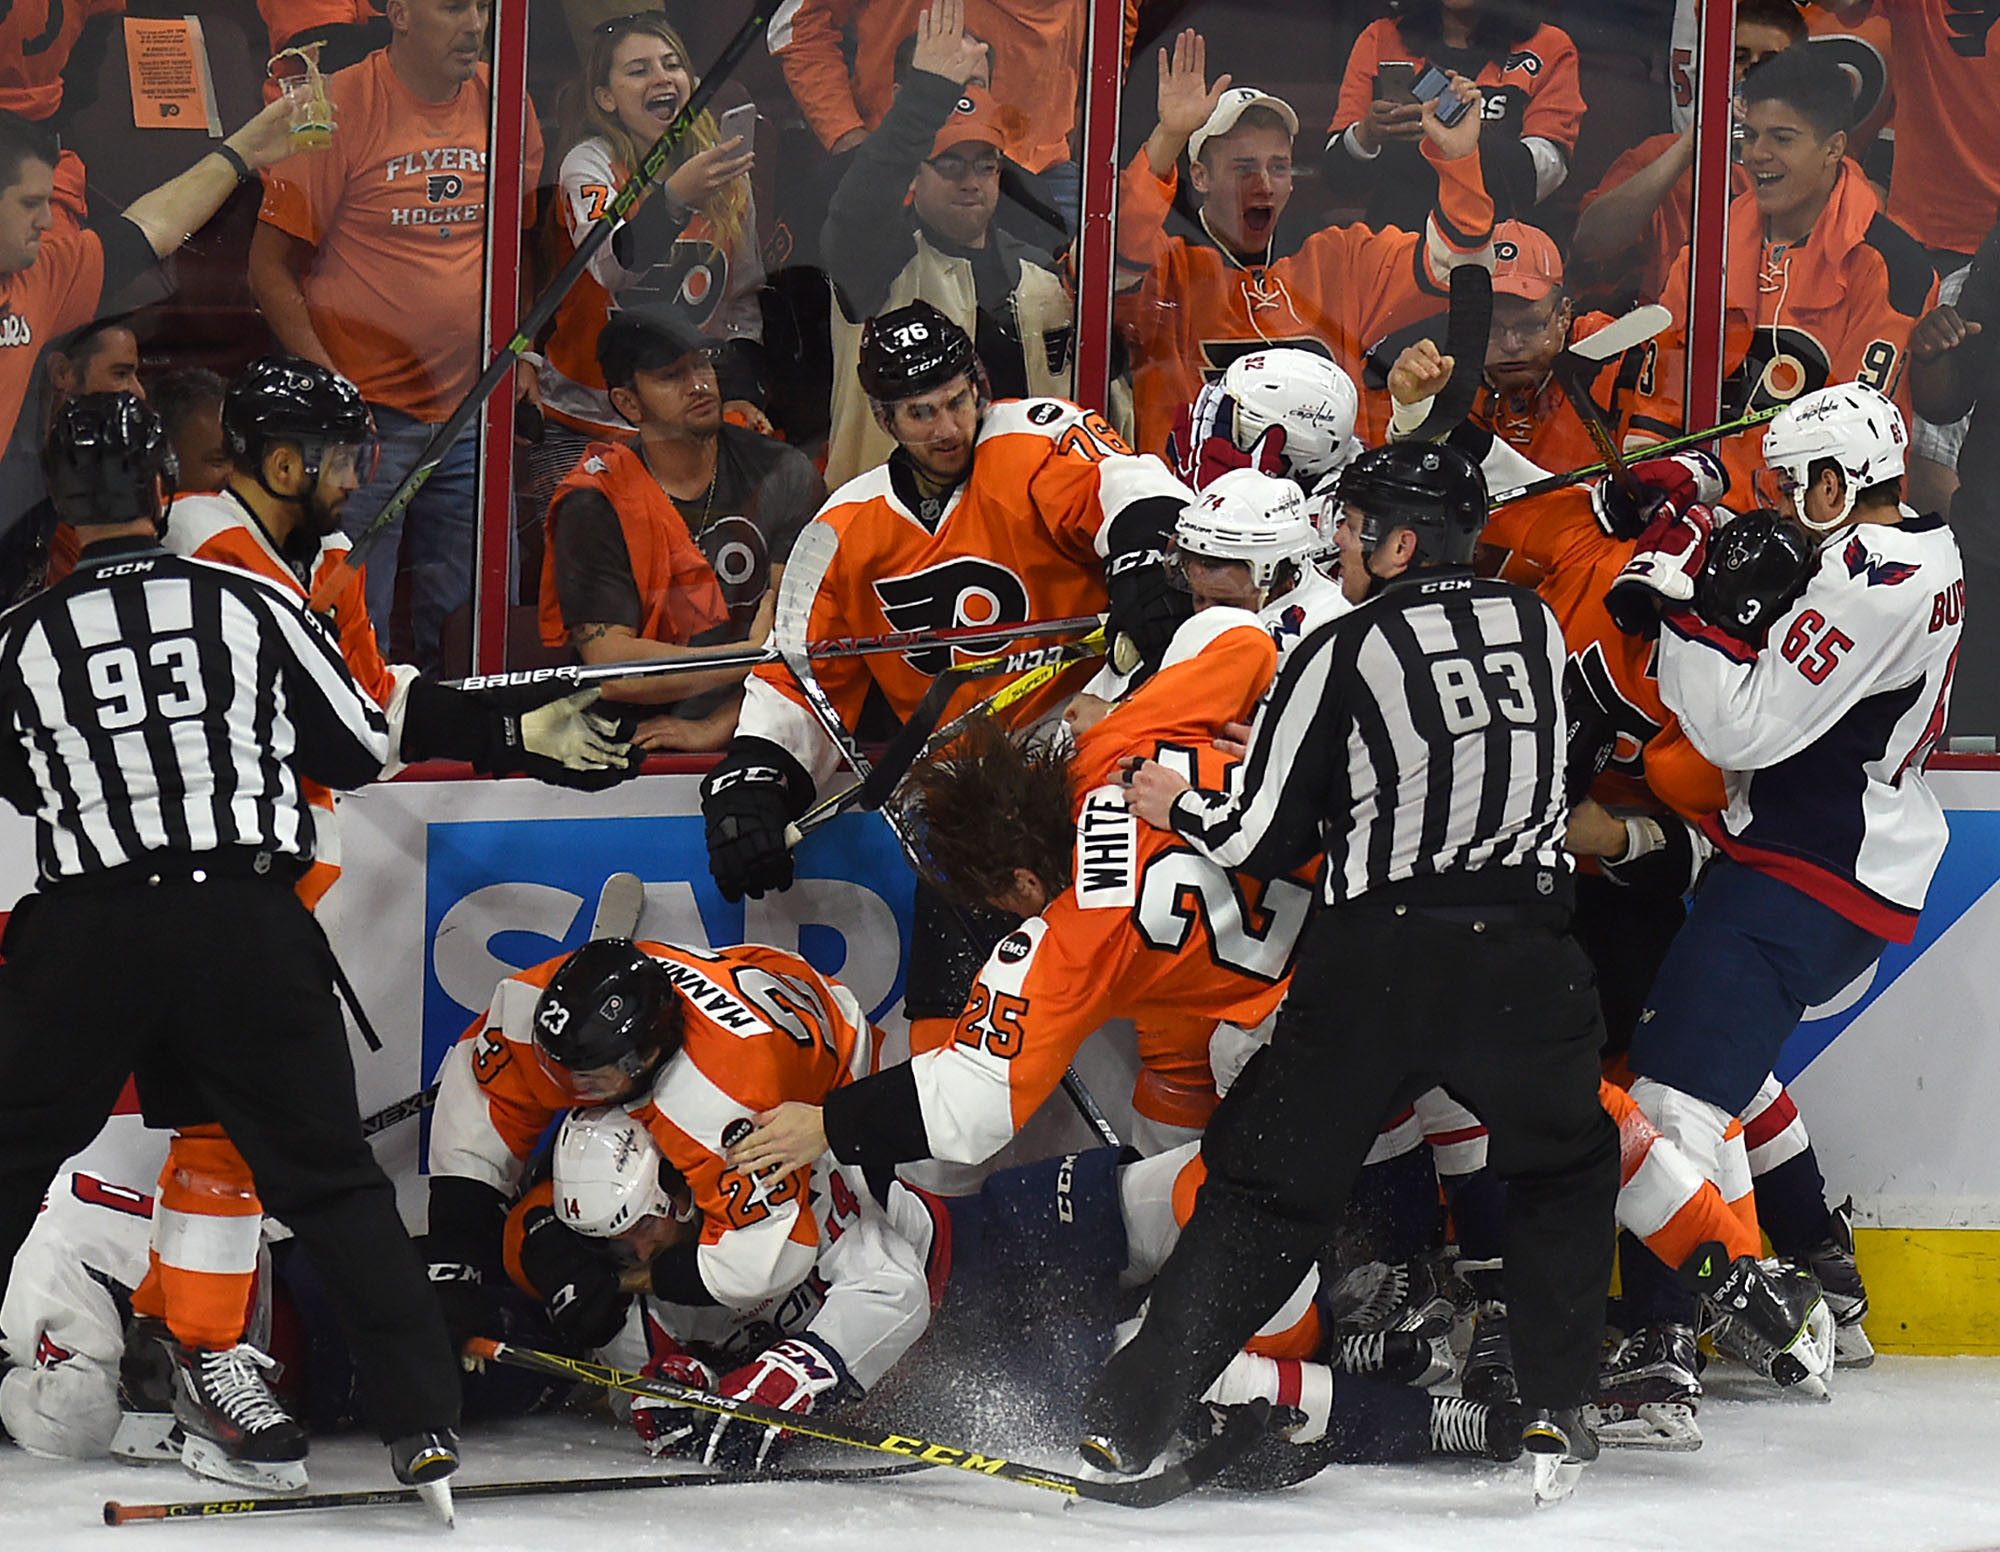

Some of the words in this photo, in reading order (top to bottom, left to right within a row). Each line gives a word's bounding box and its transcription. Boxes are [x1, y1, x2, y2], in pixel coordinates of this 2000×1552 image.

[893, 322, 929, 347] 76
[907, 356, 943, 376] CCM
[1057, 411, 1137, 462] 76
[1202, 494, 1225, 511] 74
[96, 561, 154, 579] CCM
[1421, 580, 1472, 594] CCM
[1738, 599, 1761, 625] 3
[1781, 608, 1856, 686] 65
[87, 637, 207, 729] 93
[463, 665, 578, 692] BAUER
[1430, 651, 1537, 735] 83
[711, 766, 788, 796] CC
[1083, 797, 1130, 893] WHITE
[1001, 940, 1028, 957] EMS
[540, 1000, 570, 1036] 23
[954, 983, 1029, 1060] 25
[1057, 1154, 1079, 1224] CCM
[564, 1198, 581, 1220] 14
[427, 1263, 482, 1286] CM
[879, 1434, 1007, 1475] CCM
[203, 1502, 255, 1514] CCM
